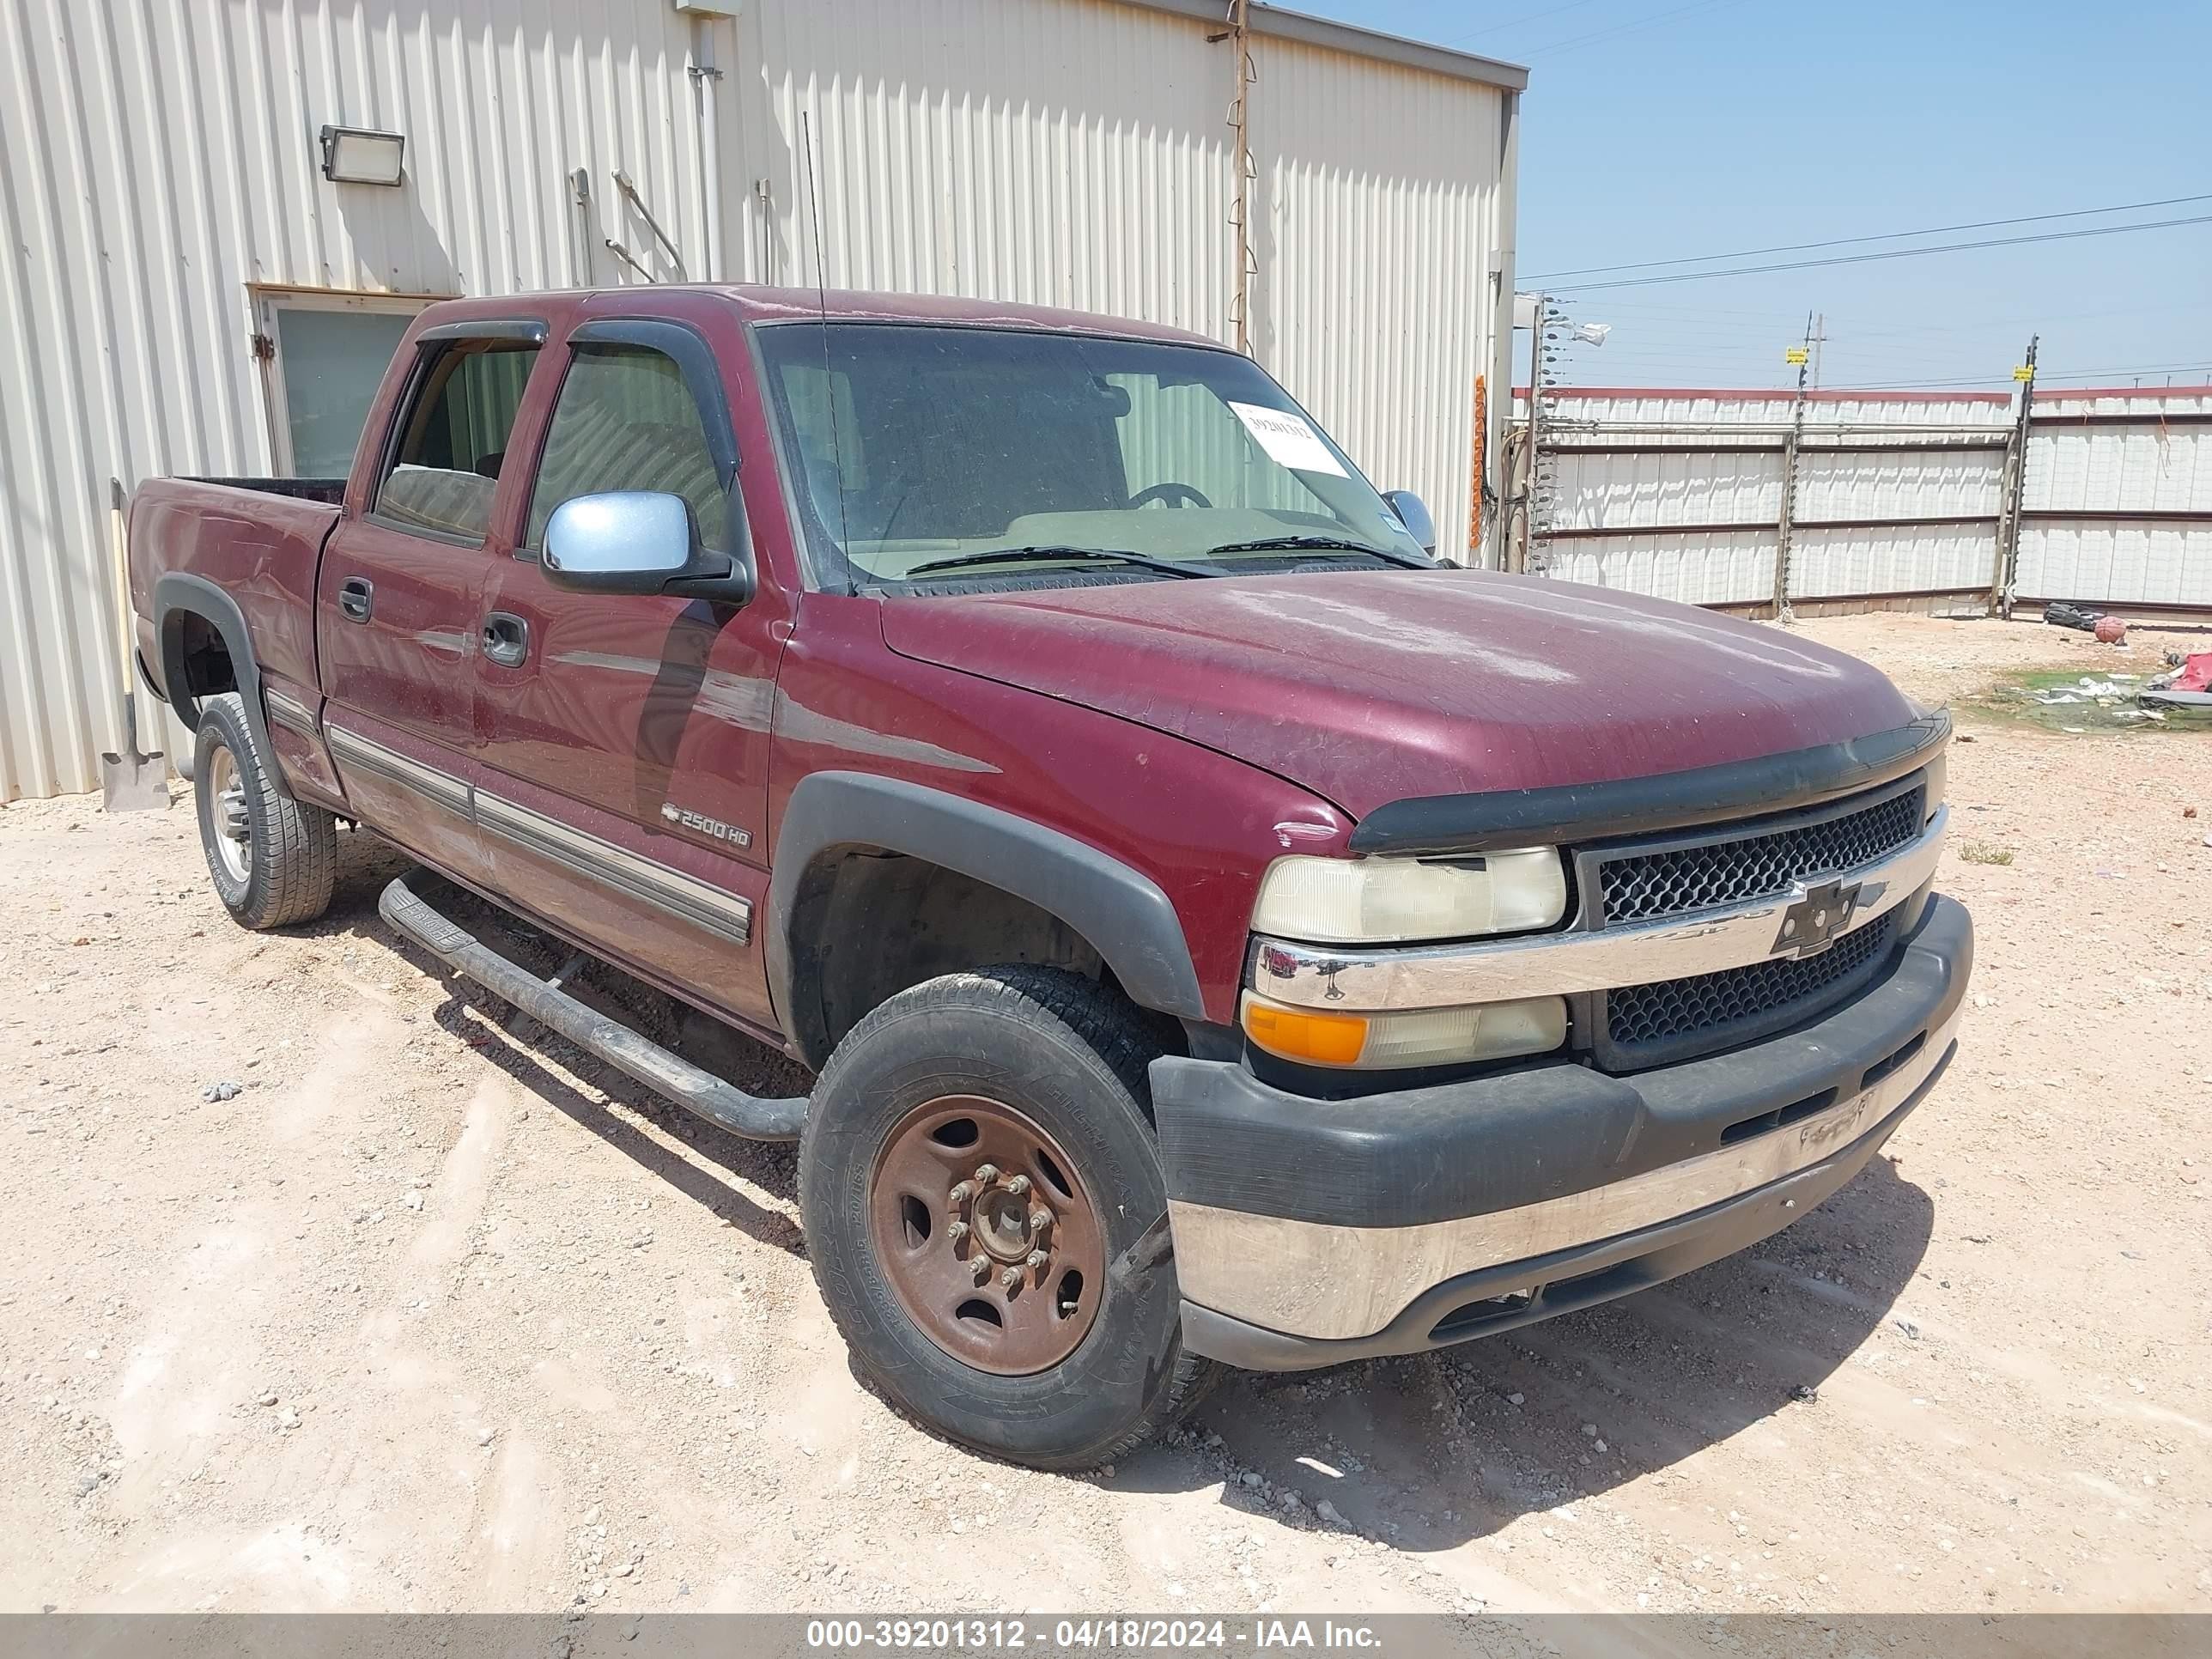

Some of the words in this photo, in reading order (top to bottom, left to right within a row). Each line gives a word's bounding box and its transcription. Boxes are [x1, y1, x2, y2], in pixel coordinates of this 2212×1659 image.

[1249, 417, 1312, 439] 39201312
[681, 811, 726, 839] 2500
[728, 829, 749, 846] HD
